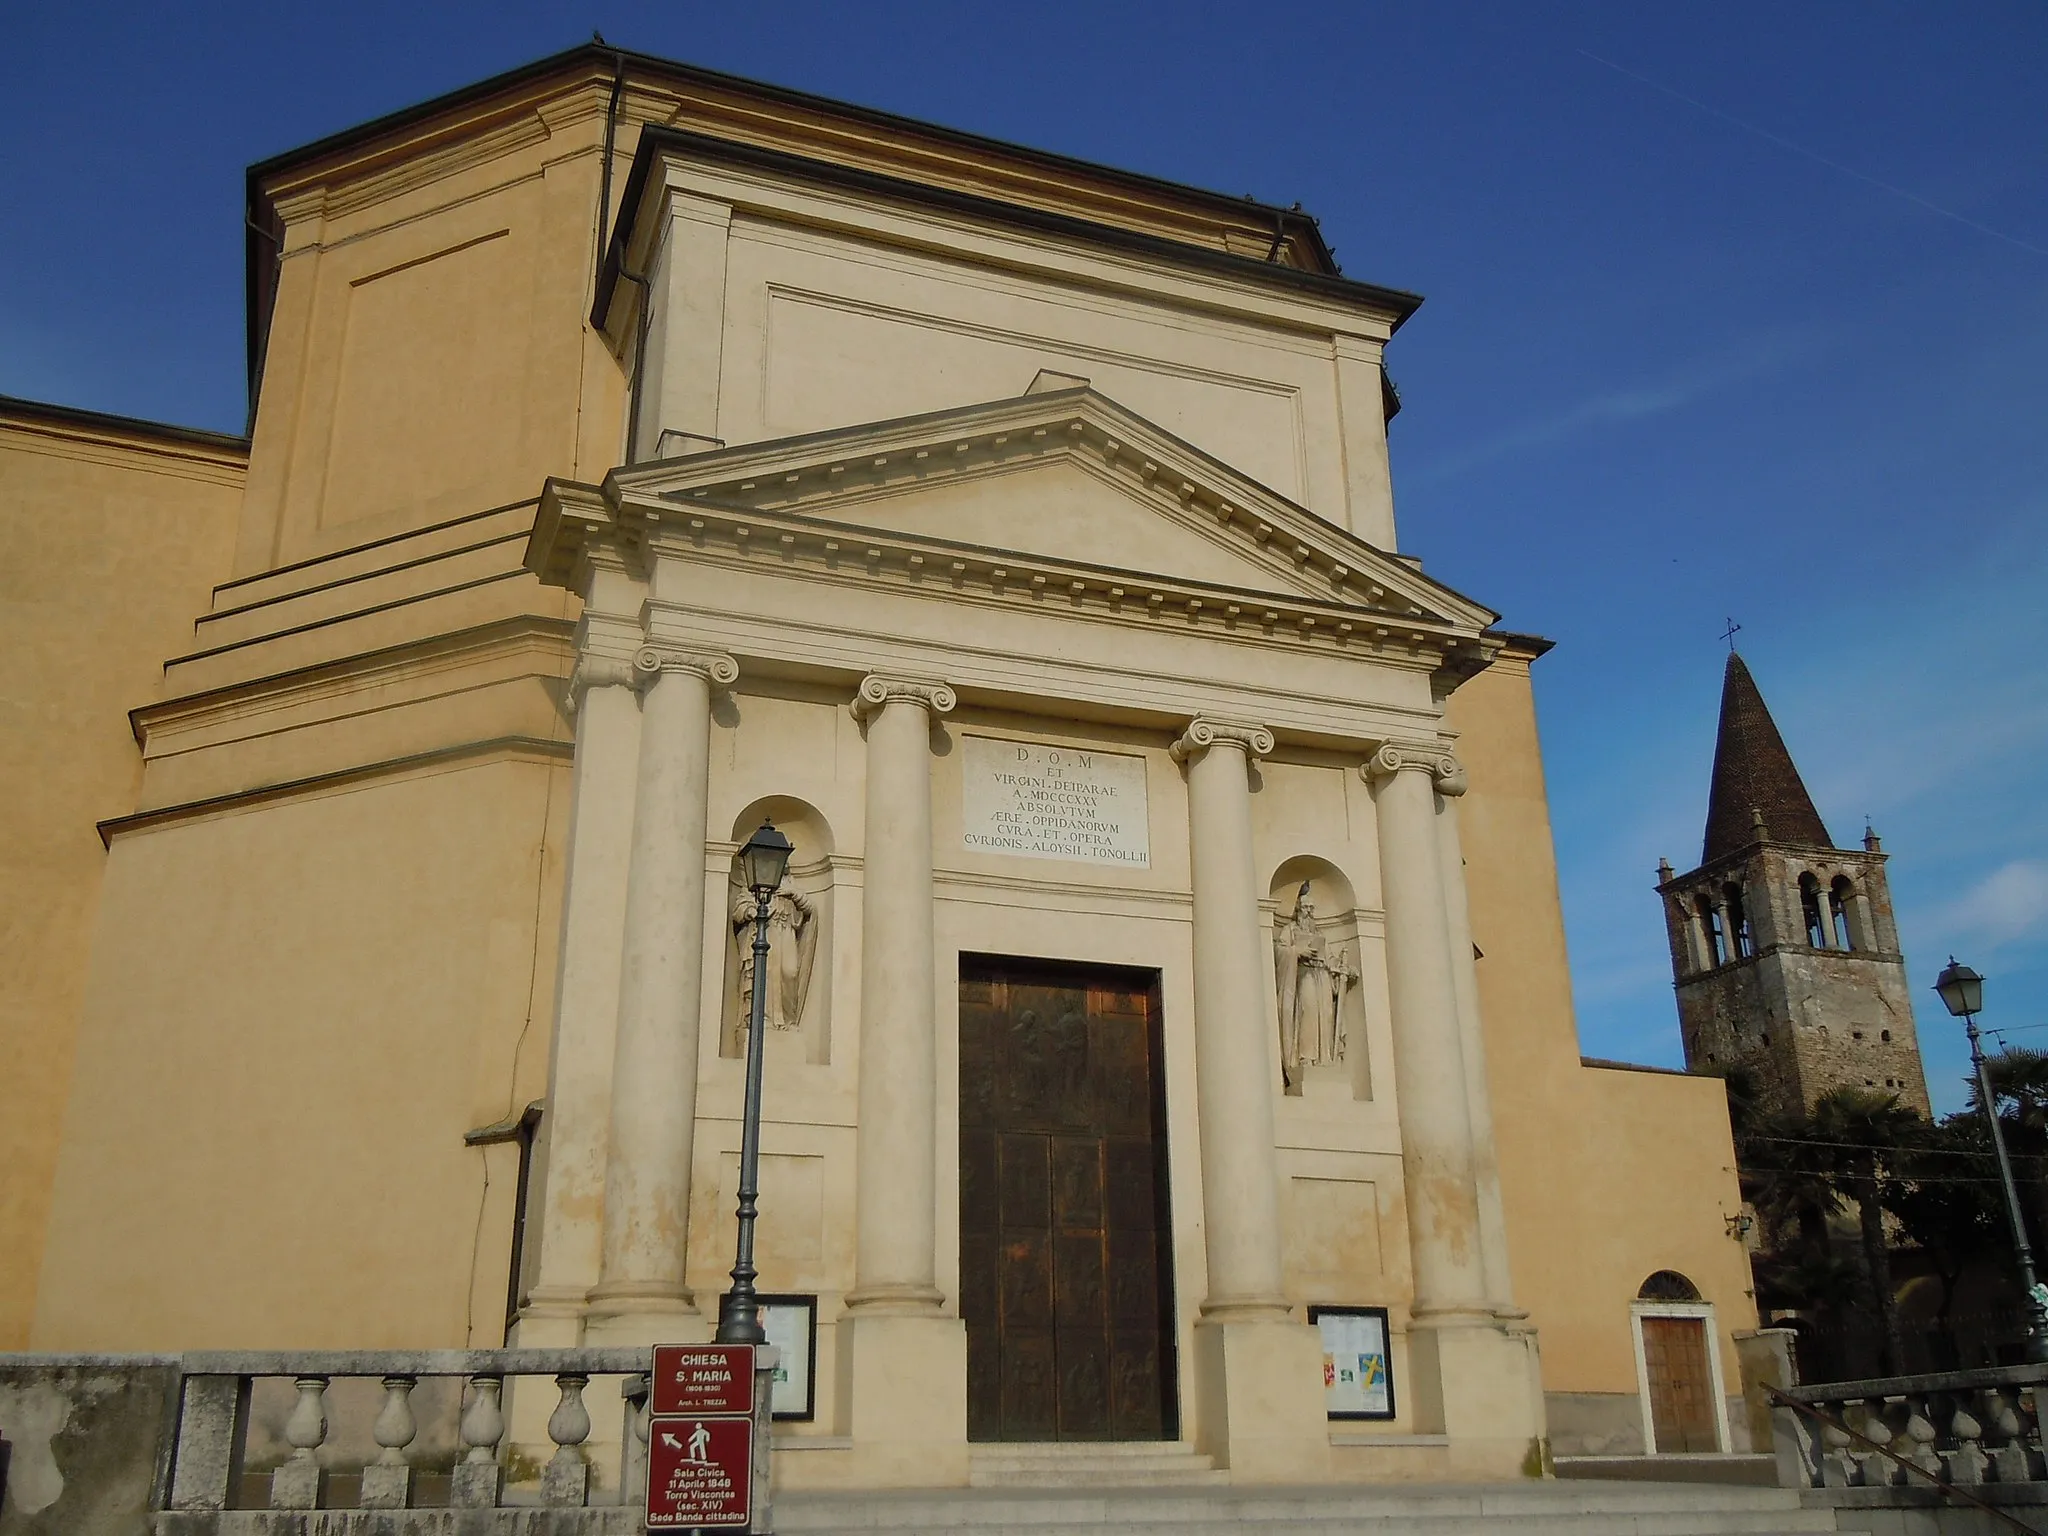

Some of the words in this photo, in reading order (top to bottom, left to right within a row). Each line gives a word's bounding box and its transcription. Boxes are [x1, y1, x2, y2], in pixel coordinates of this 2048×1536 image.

[1047, 768, 1063, 778] ET
[681, 1354, 728, 1366] CHIESA
[675, 1371, 688, 1382] S.
[693, 1370, 732, 1382] MARIA
[703, 1398, 727, 1406] TREZZA
[674, 1468, 695, 1478] Sala
[697, 1468, 725, 1477] Civica
[669, 1480, 676, 1489] 11
[678, 1479, 705, 1489] Aprile
[665, 1490, 688, 1500] Torre
[691, 1489, 736, 1500] Viscontea
[677, 1501, 700, 1510] (sec.
[701, 1500, 723, 1510] XIV)
[650, 1512, 673, 1522] Sede
[675, 1512, 703, 1521] Banda
[706, 1511, 745, 1520] cittadina
